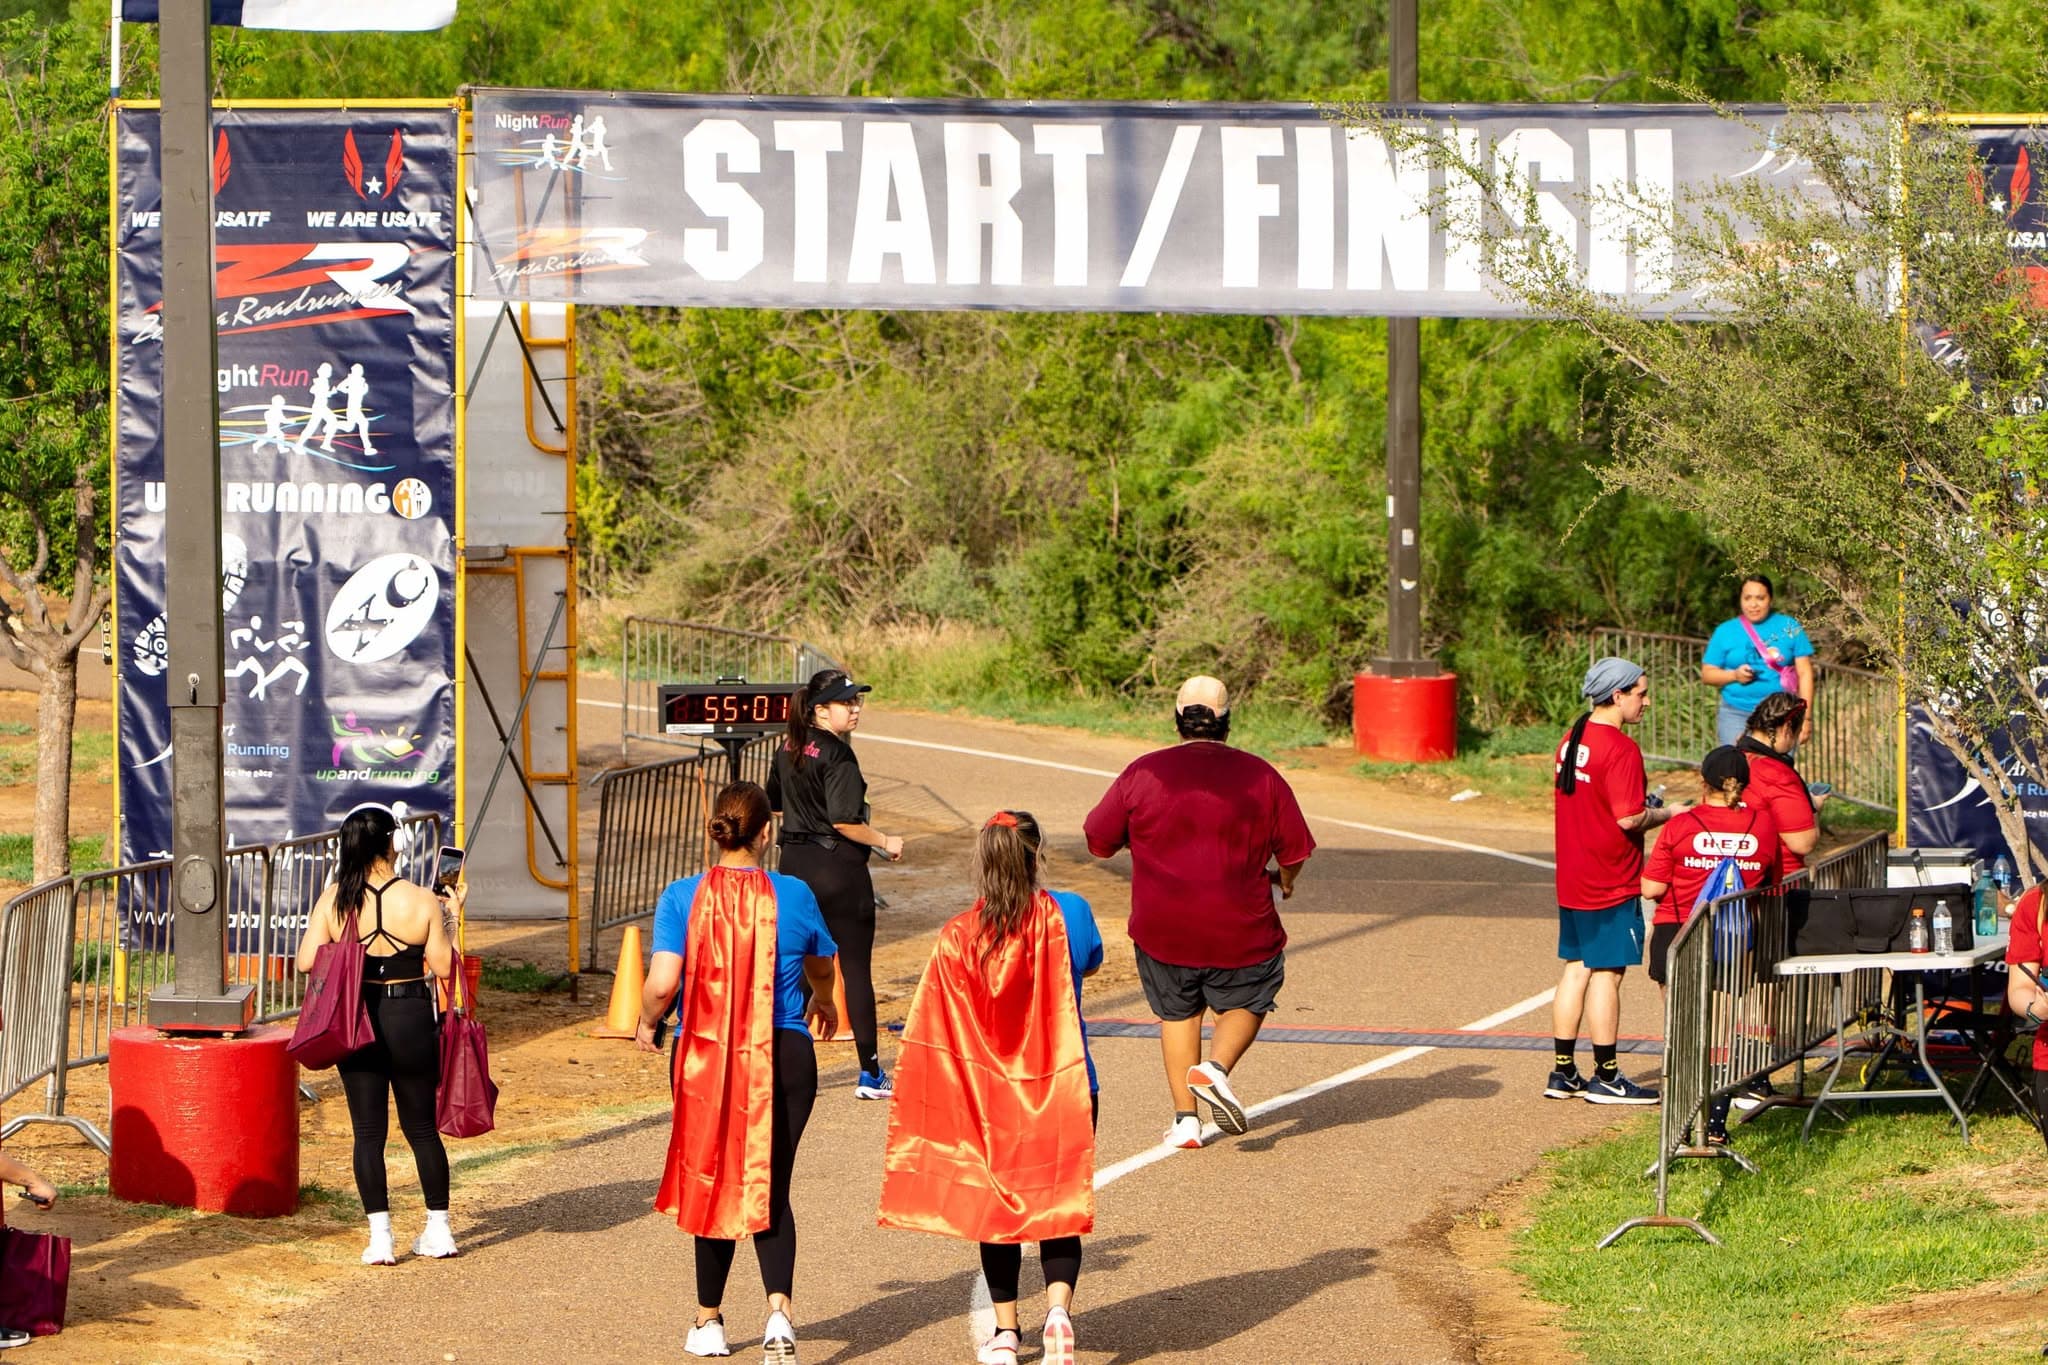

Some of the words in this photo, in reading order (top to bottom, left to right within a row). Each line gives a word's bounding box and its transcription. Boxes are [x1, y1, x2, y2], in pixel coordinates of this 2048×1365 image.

[495, 114, 570, 132] NightRun
[684, 118, 1675, 294] START/FINISH
[132, 212, 161, 227] WE
[306, 211, 337, 227] WE
[339, 211, 377, 227] ARE
[381, 211, 441, 228] USATF
[2007, 231, 2048, 248] USA
[217, 363, 309, 392] ghtRun
[226, 481, 391, 514] RUNNING
[227, 743, 289, 759] Running
[316, 767, 439, 784] upandrunning
[1684, 856, 1721, 870] Helpi
